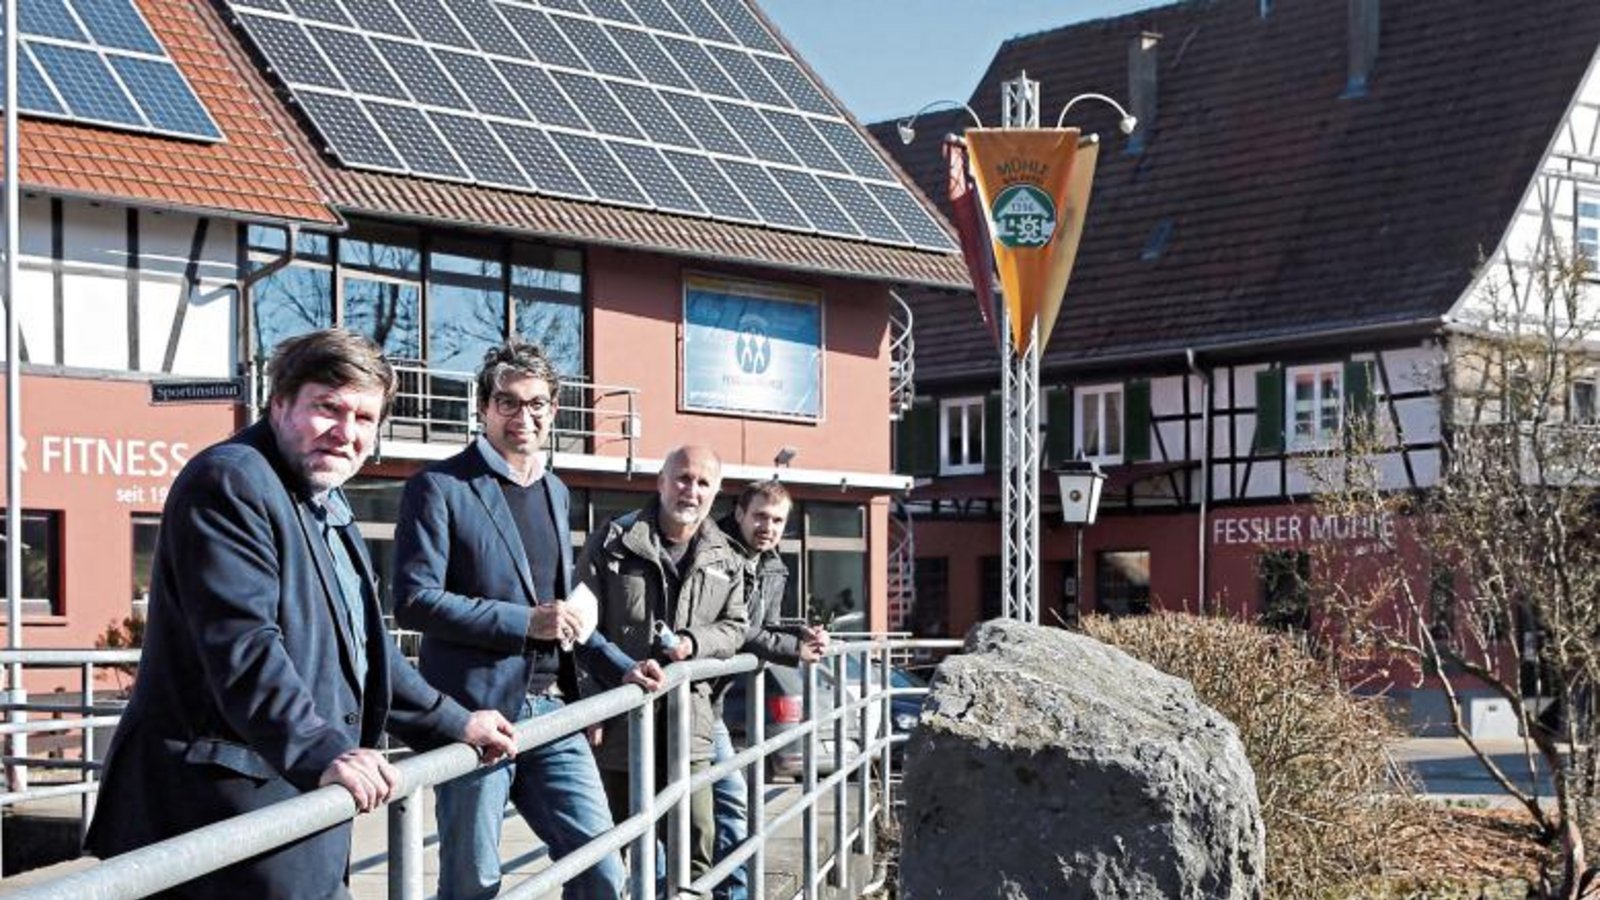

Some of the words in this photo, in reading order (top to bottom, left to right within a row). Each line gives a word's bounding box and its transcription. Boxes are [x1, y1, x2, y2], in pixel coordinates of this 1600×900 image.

[157, 385, 238, 401] Sportinstitut
[42, 435, 190, 477] FITNESS
[116, 485, 144, 502] seit
[1213, 514, 1303, 544] FESSLER
